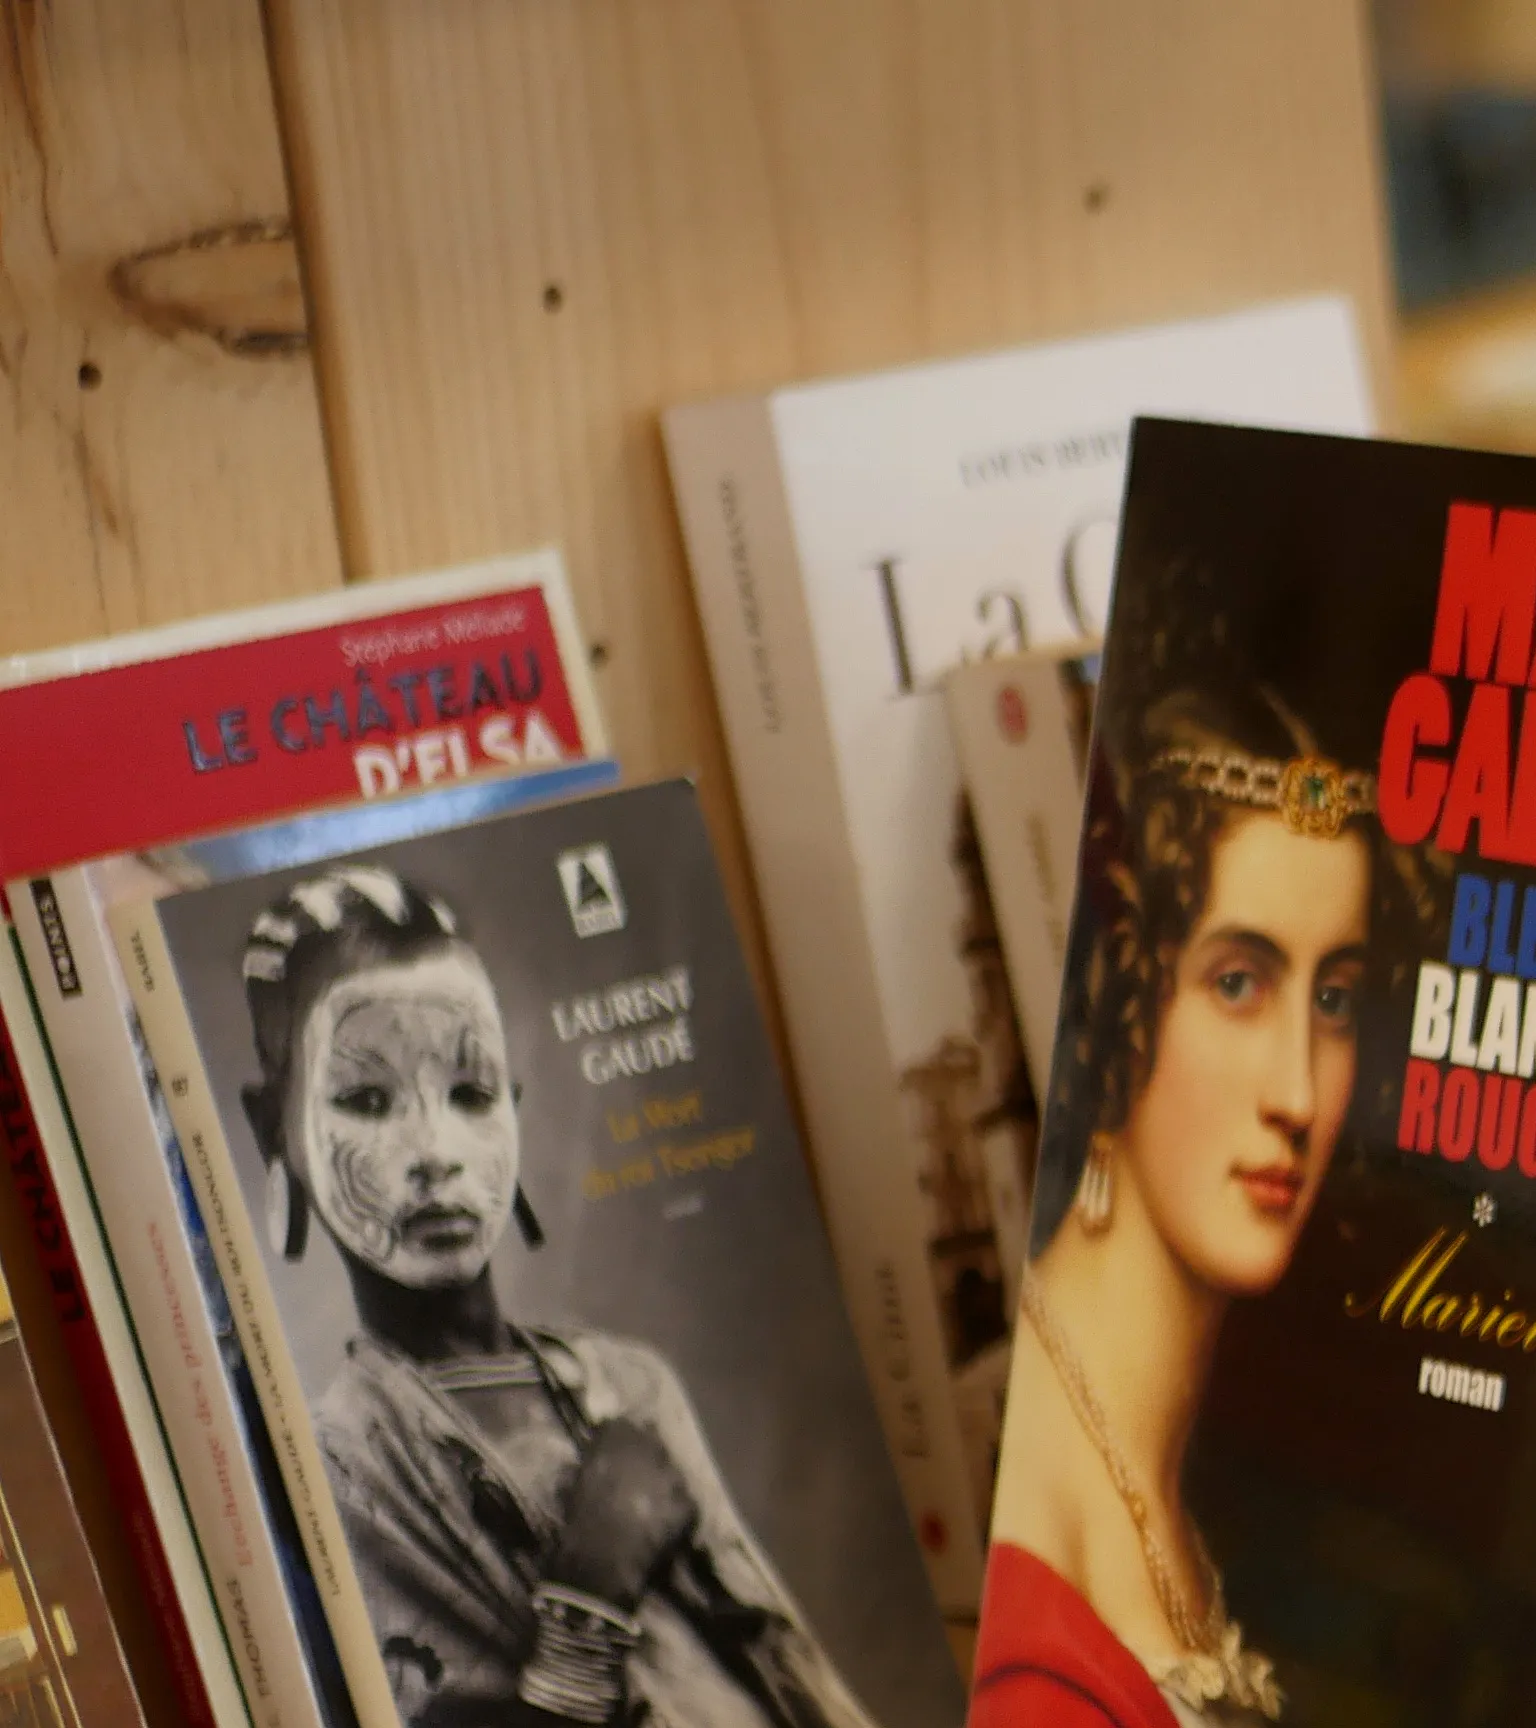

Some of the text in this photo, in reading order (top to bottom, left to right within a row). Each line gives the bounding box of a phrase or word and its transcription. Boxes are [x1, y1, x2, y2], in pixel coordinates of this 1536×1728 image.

[182, 647, 544, 775] LE CHÂTEAU
[38, 893, 79, 992] POINTS
[550, 967, 695, 1043] LAURENT
[581, 1015, 696, 1085] GAUDÉ
[1418, 1359, 1506, 1413] roman
[220, 1573, 276, 1701] THOMAS
